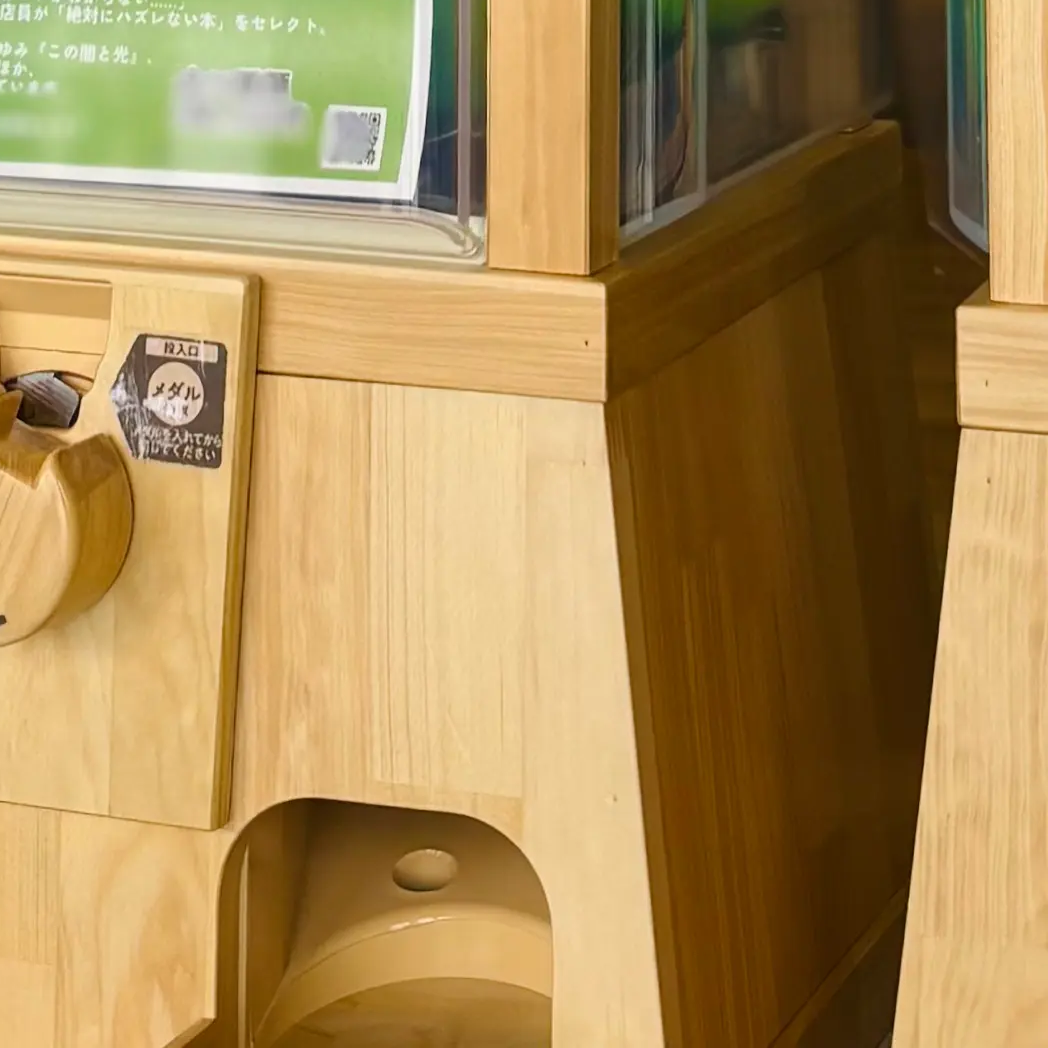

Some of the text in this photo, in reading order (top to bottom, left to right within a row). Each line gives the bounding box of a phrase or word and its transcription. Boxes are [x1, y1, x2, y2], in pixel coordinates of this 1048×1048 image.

[164, 341, 199, 357] 投入口
[152, 381, 201, 401] メダル
